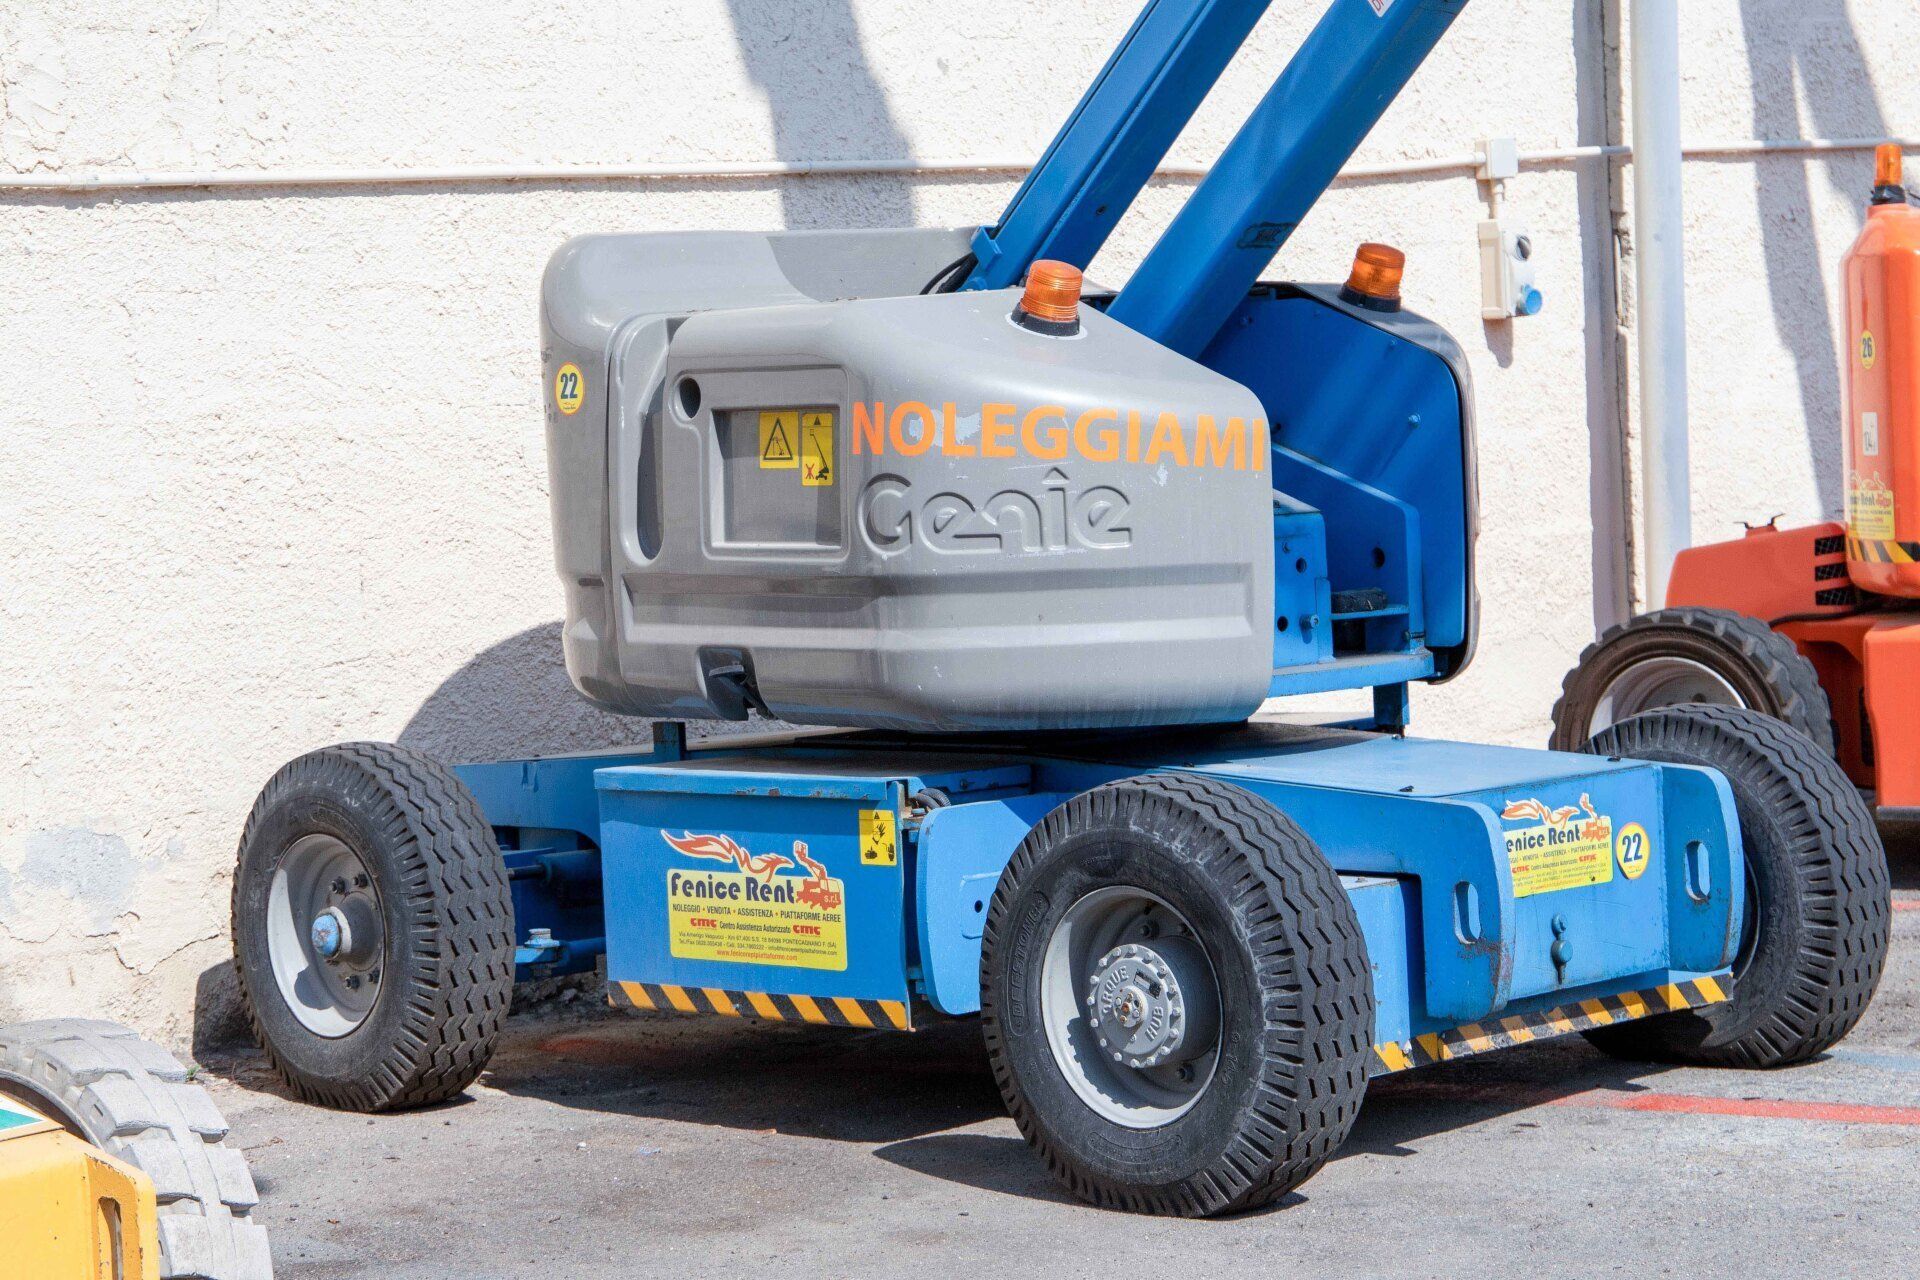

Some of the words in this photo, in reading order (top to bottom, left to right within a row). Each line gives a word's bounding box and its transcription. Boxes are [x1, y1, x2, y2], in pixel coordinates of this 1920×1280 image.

[1862, 337, 1873, 358] 26
[560, 373, 578, 399] 22
[851, 401, 1264, 472] NOLEGGIAMI
[857, 467, 1132, 556] Genie
[1506, 832, 1545, 852] enice
[1548, 824, 1580, 845] Rent
[1622, 833, 1643, 863] 22
[745, 876, 794, 904] Rent
[672, 903, 701, 913] NOLEGGIO
[706, 905, 732, 915] VENDITA
[737, 907, 774, 918] ASSISTENZA
[780, 910, 821, 921] PIATTAFORME
[822, 913, 841, 923] AEREE
[719, 920, 736, 930] Centro
[736, 922, 762, 932] Assistenza
[762, 924, 791, 934] Autorizzato
[1101, 965, 1129, 1016] ORQUE
[1145, 1006, 1164, 1041] HUB
